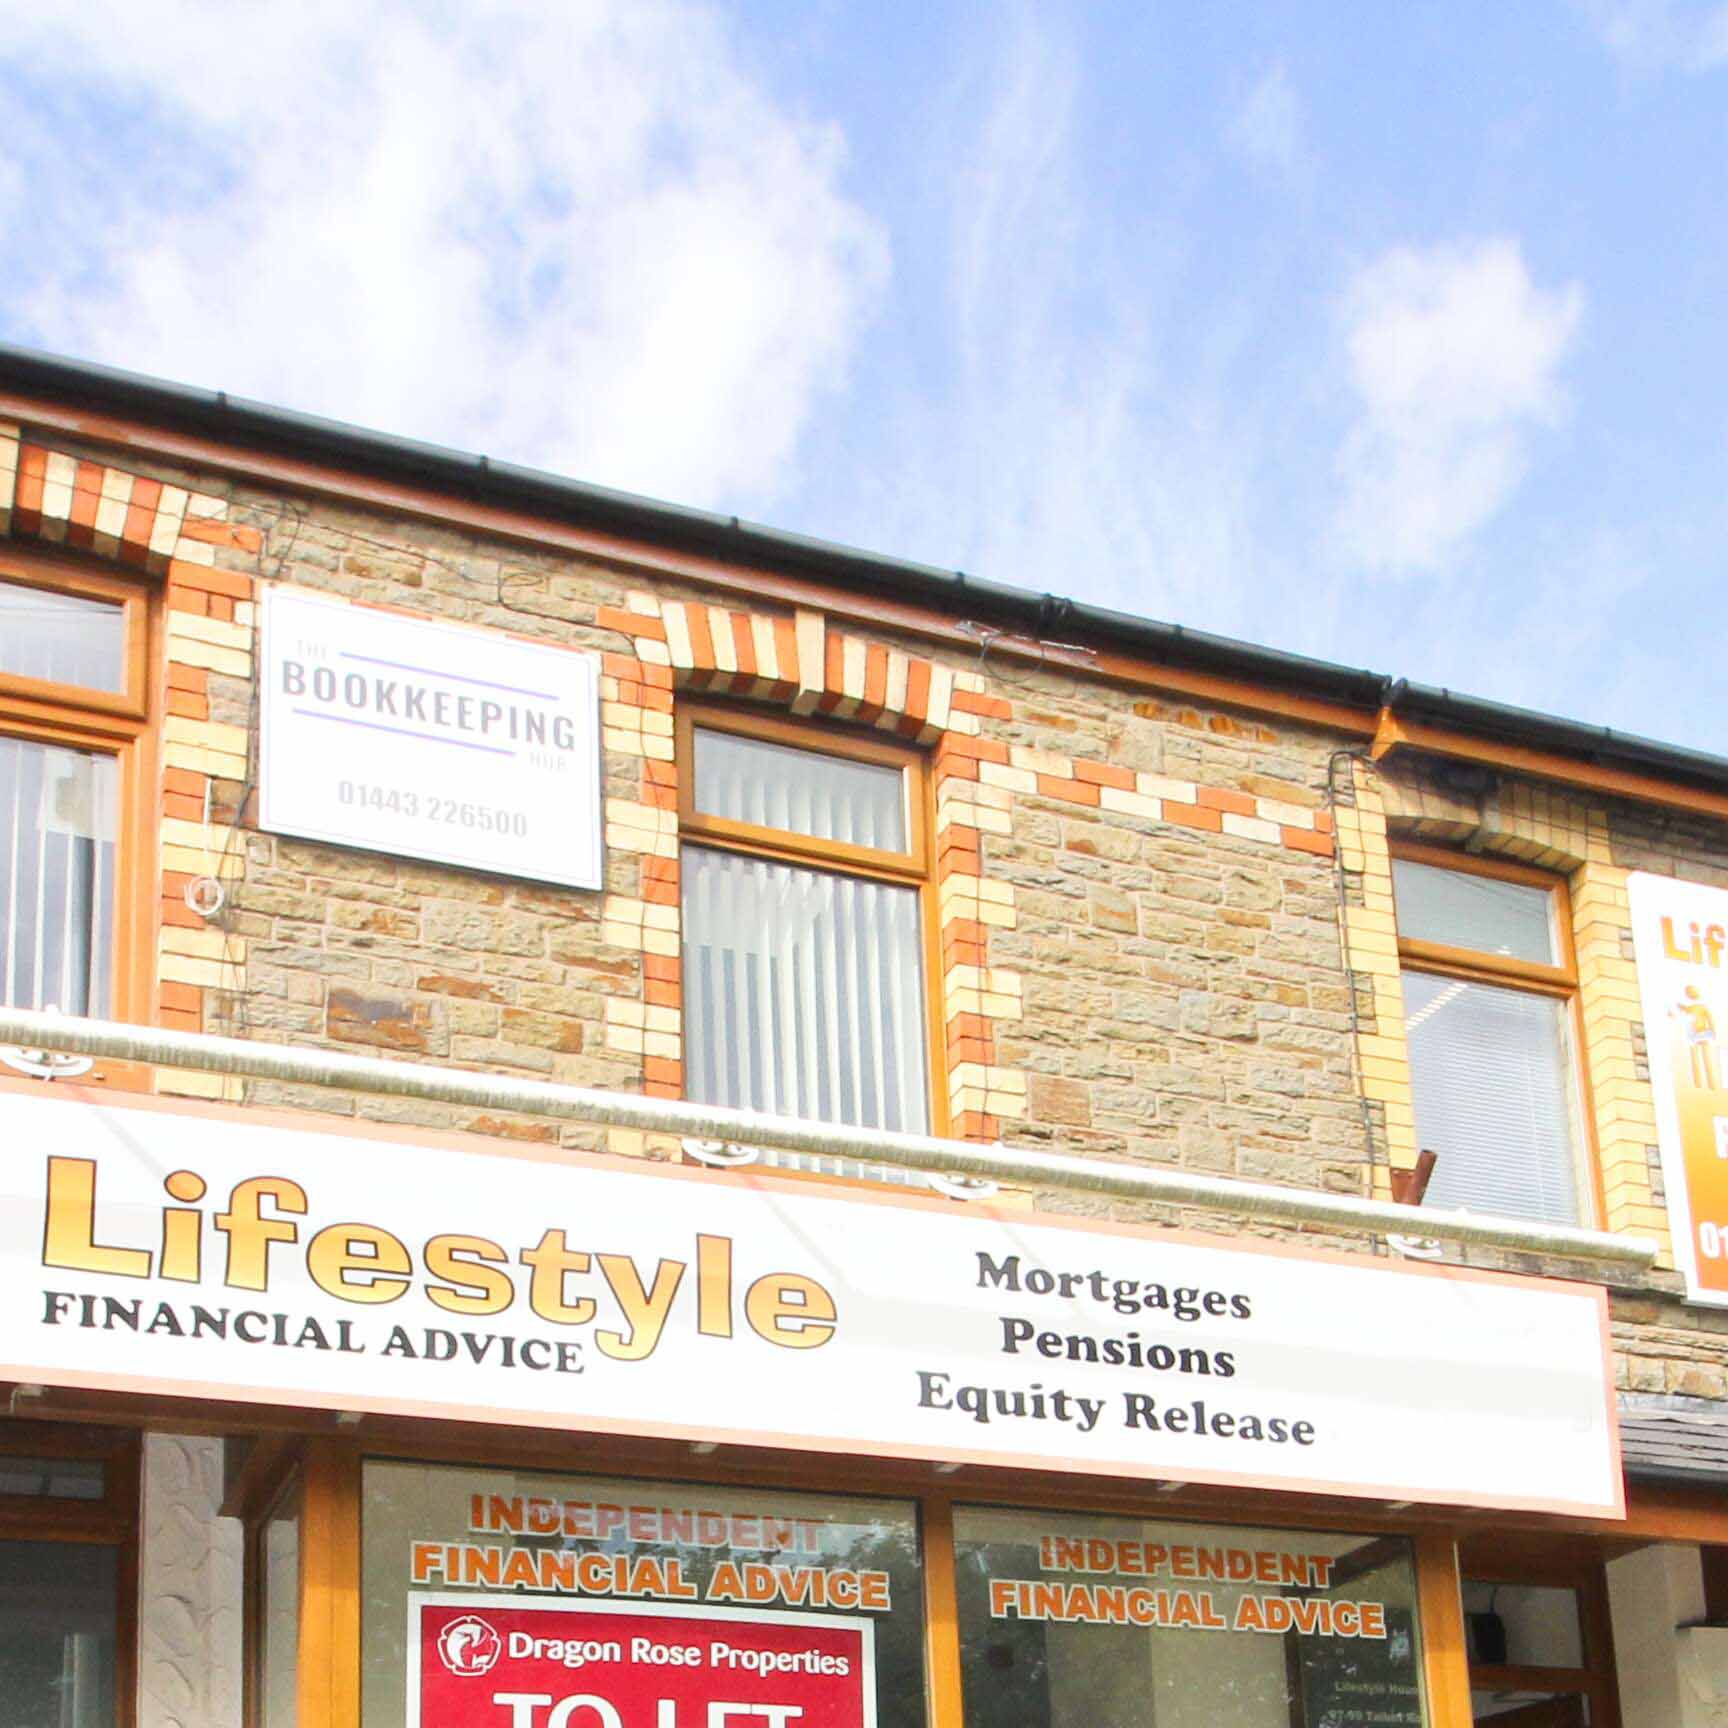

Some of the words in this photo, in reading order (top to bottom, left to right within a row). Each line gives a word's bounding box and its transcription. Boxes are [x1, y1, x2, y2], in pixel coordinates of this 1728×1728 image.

[281, 659, 576, 752] BOOKKEEPING
[337, 780, 420, 816] 01443
[426, 795, 529, 838] 226500
[41, 1154, 838, 1362] Lifestyle
[975, 1251, 1253, 1322] Mortgages
[42, 1290, 365, 1353] FINANCIAL
[380, 1326, 584, 1376] ADVICE
[998, 1316, 1236, 1378] Pensions
[917, 1371, 1106, 1432] Equity
[1123, 1392, 1317, 1446] Release
[469, 1493, 825, 1554] INDEPENDENT
[410, 1540, 698, 1600] FINANCIAL
[705, 1564, 892, 1612] ADVICE
[1038, 1536, 1335, 1588] INDEPENDENT
[988, 1578, 1228, 1631] FINANCIAL
[1233, 1594, 1387, 1640] ADVICE
[508, 1632, 621, 1668] Dragon
[631, 1637, 702, 1667] Rose
[710, 1642, 850, 1677] Properties
